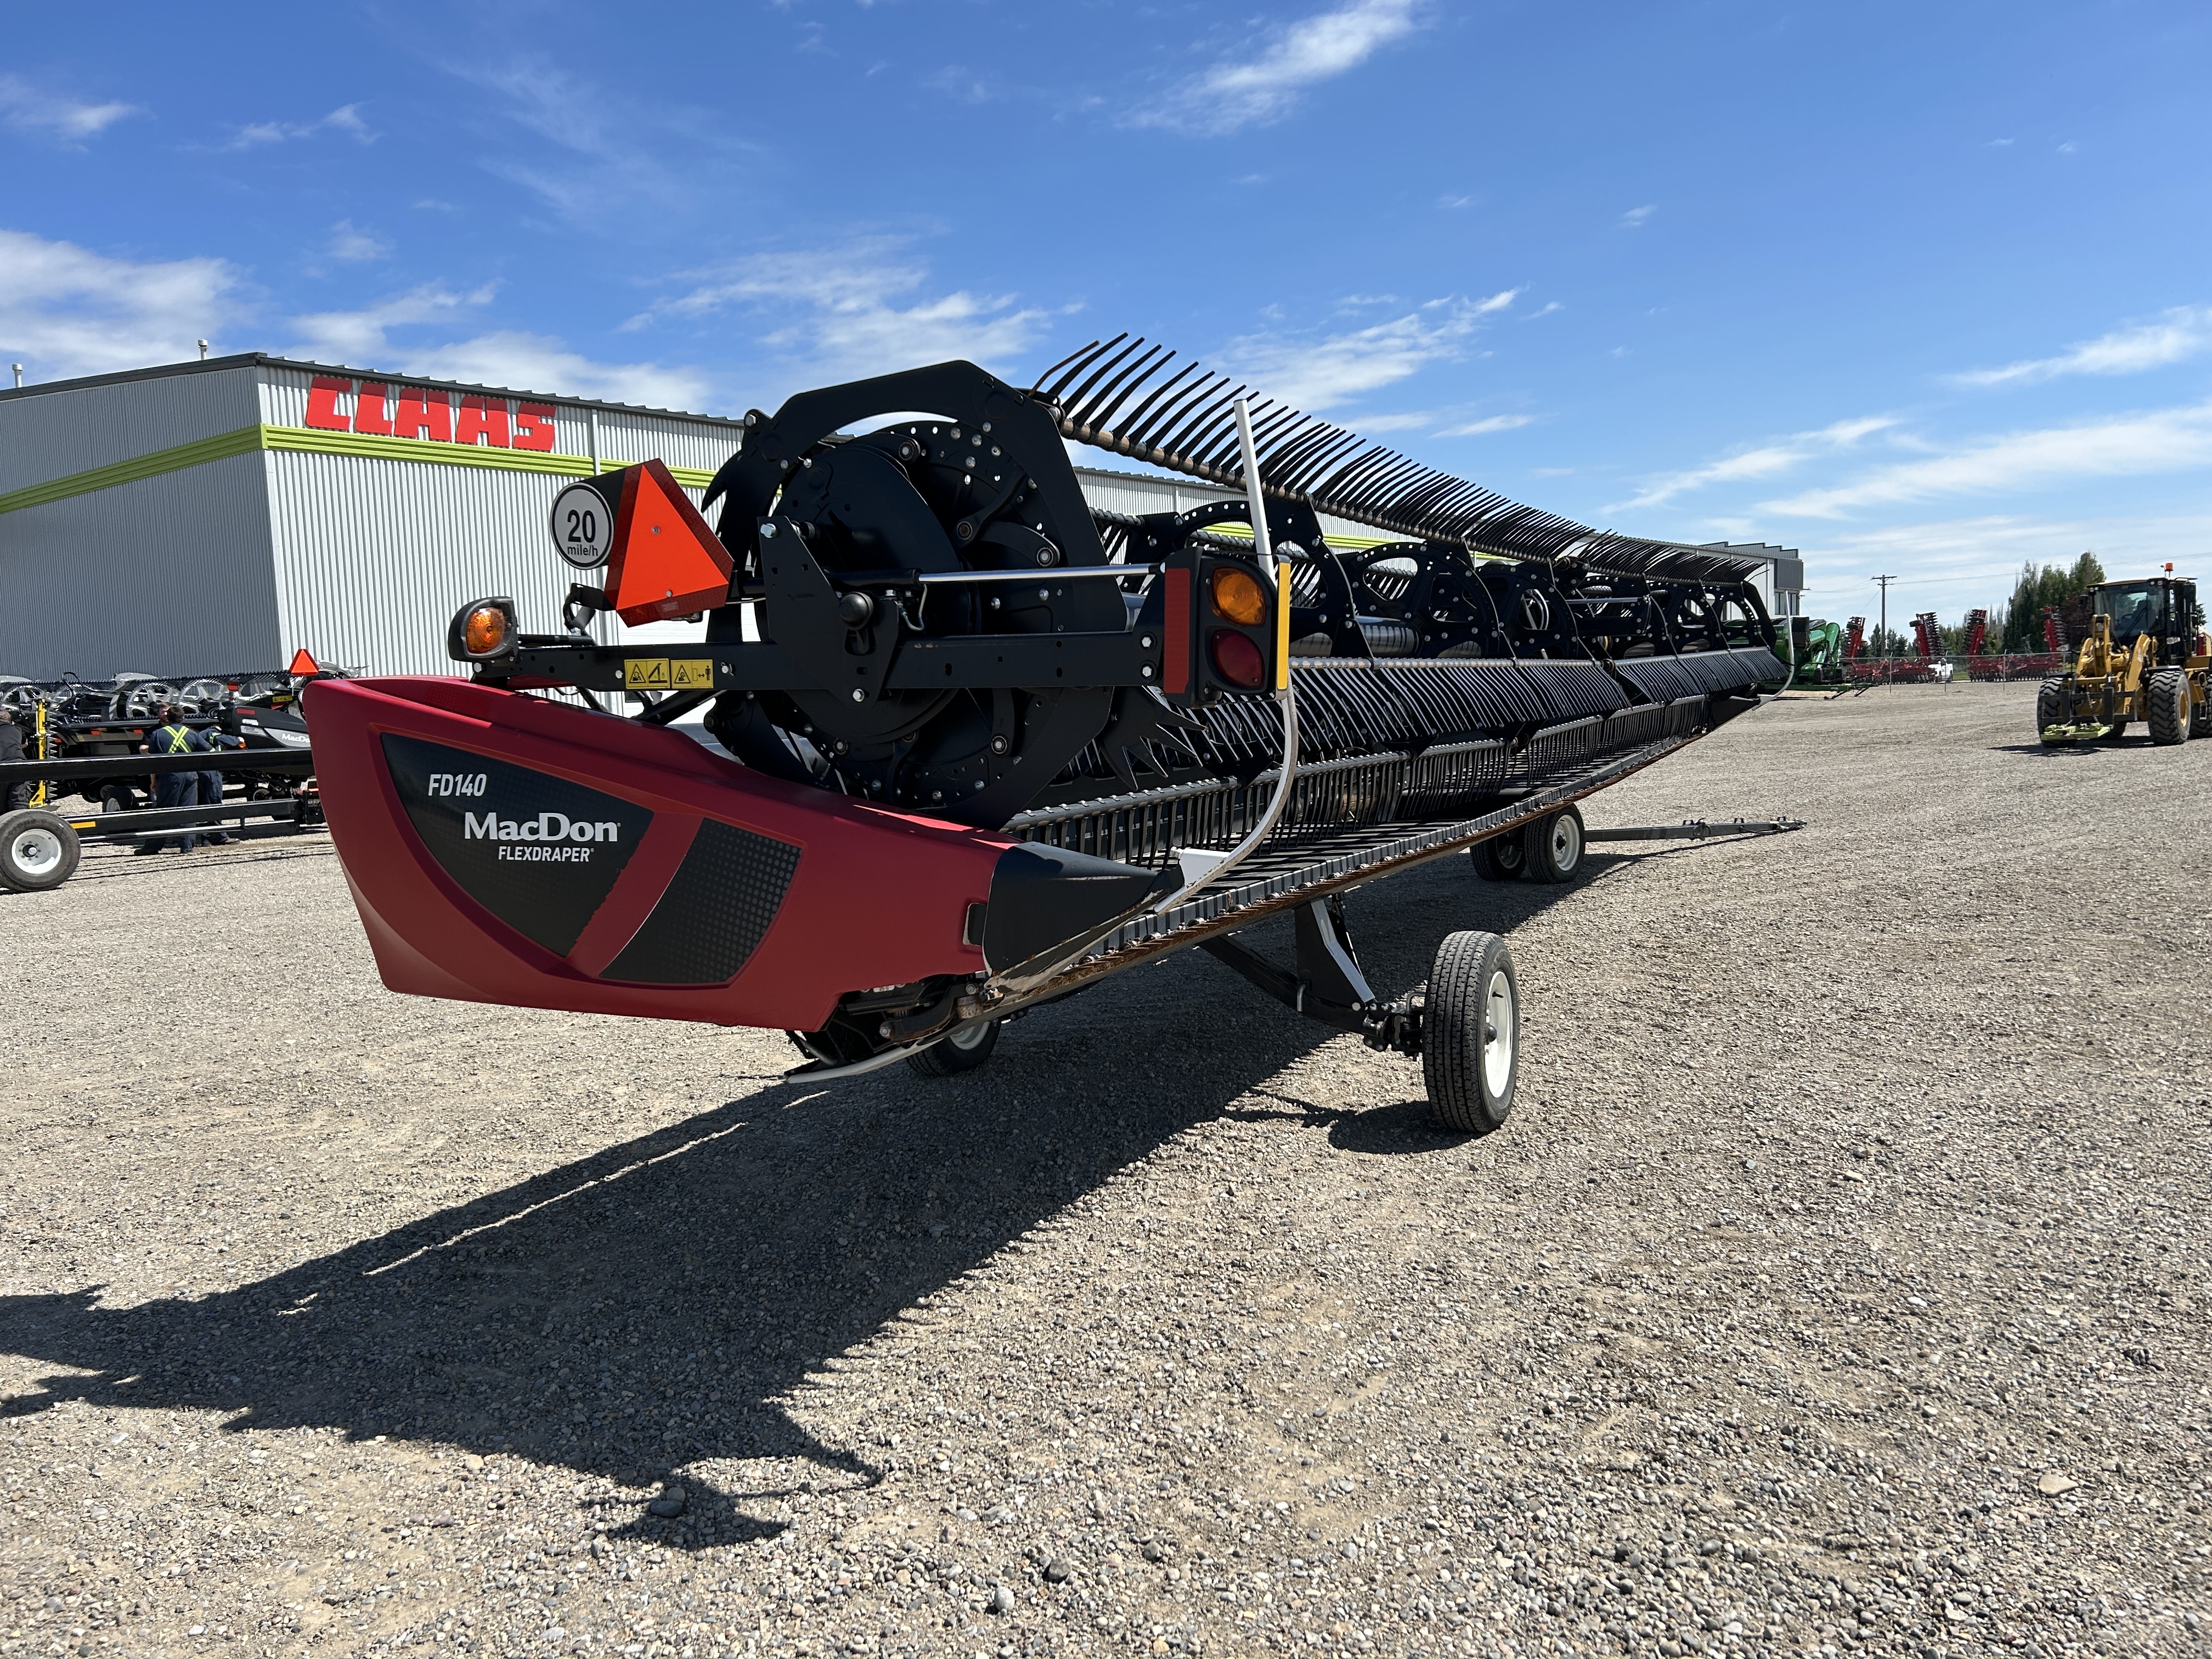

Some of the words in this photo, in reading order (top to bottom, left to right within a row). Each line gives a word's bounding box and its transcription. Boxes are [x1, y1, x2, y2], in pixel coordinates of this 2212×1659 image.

[306, 376, 556, 451] CLAAS
[567, 509, 596, 544] 20
[567, 544, 599, 557] mile/h
[281, 733, 311, 743] MacDo
[428, 774, 487, 797] FD140
